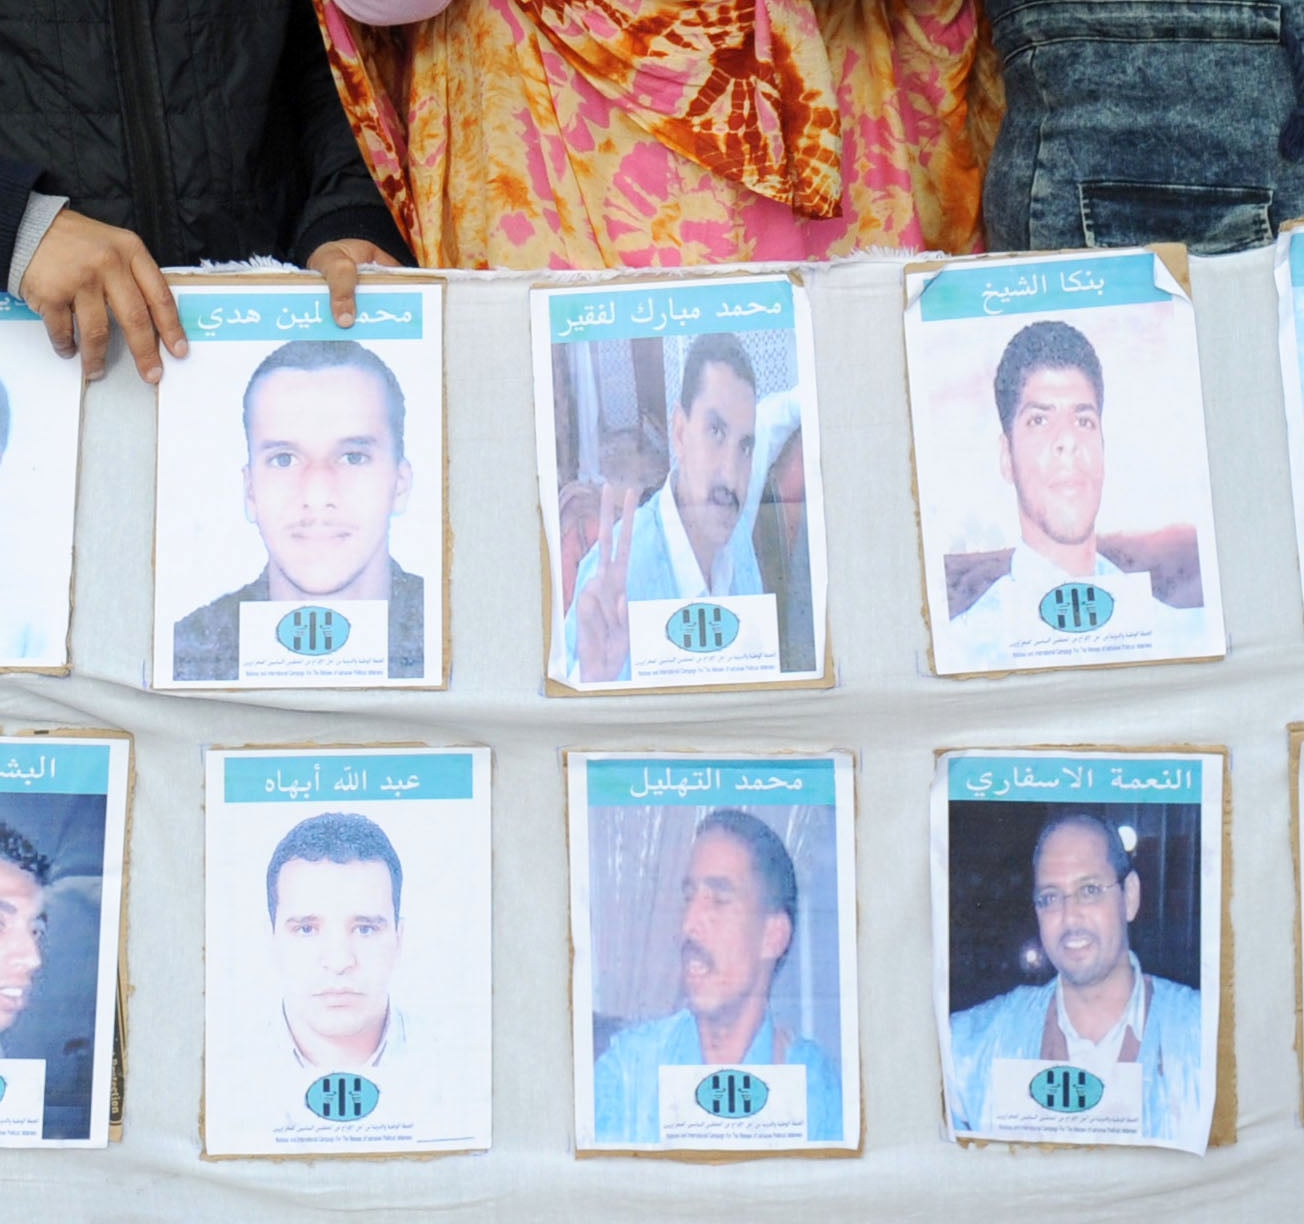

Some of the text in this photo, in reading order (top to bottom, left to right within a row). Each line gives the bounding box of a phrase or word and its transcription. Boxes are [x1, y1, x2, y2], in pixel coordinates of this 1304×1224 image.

[981, 269, 1105, 318] بنكا الشيخ
[197, 306, 262, 337] هدي
[355, 308, 413, 325] محم
[558, 296, 782, 338] محمد مبارك لفقير
[264, 762, 421, 795] عبد الله أبهاه
[629, 766, 804, 800] محمد التهليل
[1110, 766, 1193, 792] النعمة
